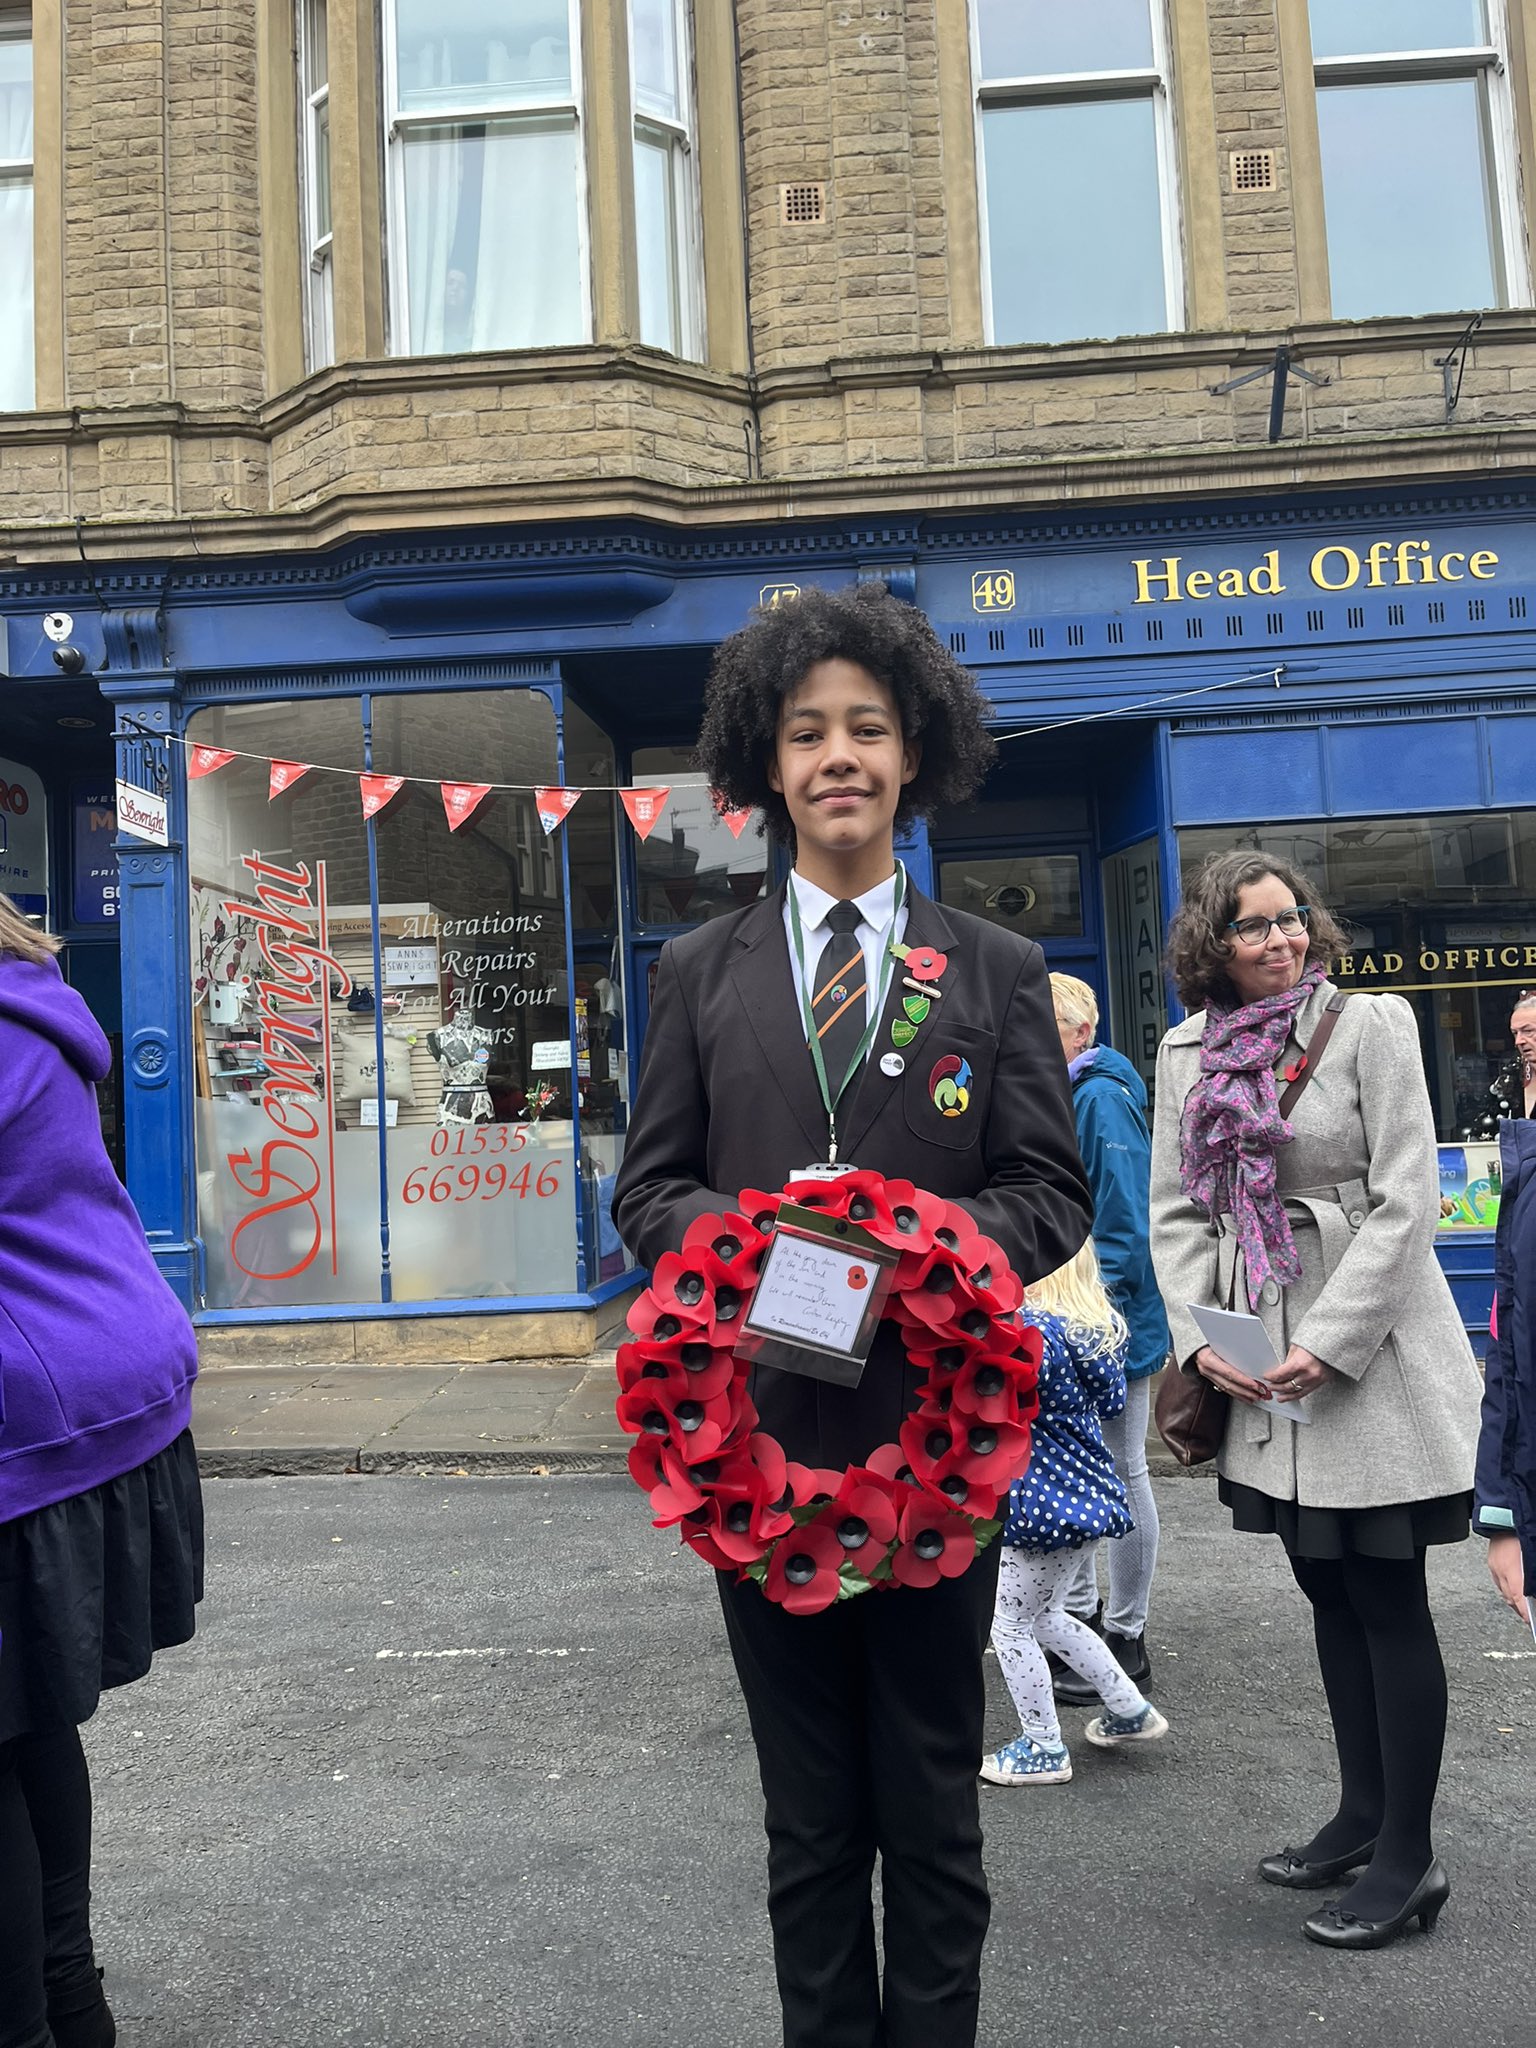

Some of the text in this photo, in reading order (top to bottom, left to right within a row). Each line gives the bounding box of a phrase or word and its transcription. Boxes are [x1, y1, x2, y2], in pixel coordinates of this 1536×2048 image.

[1131, 540, 1500, 604] Head Office
[974, 576, 1012, 607] 49
[119, 795, 165, 835] Sewright
[398, 910, 543, 940] Alterations
[441, 946, 537, 981] Repairs
[1419, 946, 1536, 971] OFFICE
[390, 981, 557, 1017] For All Your
[227, 849, 353, 1280] Sewright
[430, 1123, 531, 1156] 01535
[402, 1159, 562, 1205] 669946
